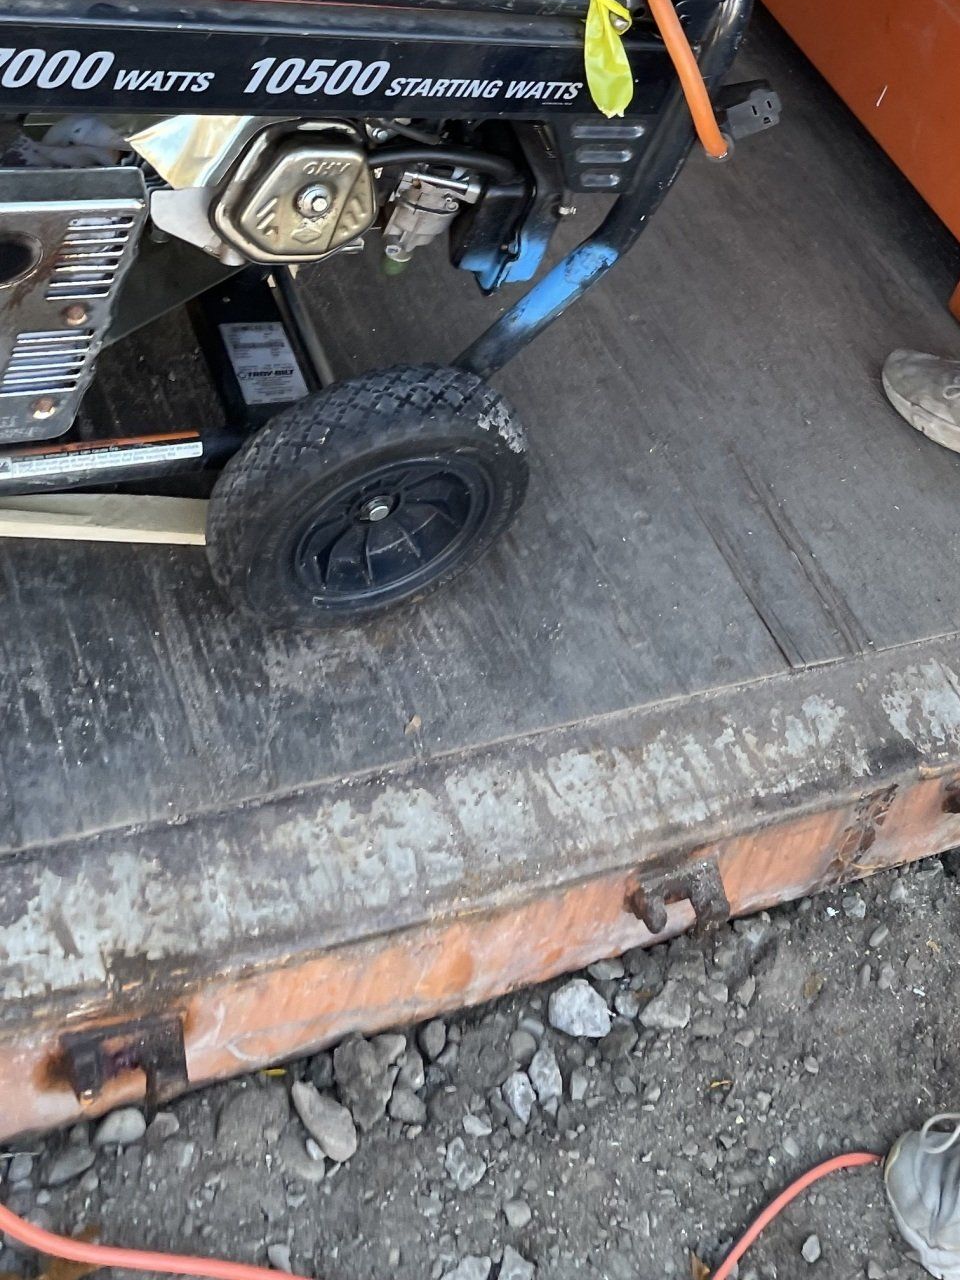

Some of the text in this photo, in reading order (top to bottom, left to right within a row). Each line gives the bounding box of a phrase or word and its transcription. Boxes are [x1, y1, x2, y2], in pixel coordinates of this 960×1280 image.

[113, 70, 215, 92] WATTS
[244, 57, 583, 100] 10500 STARTING WATTS
